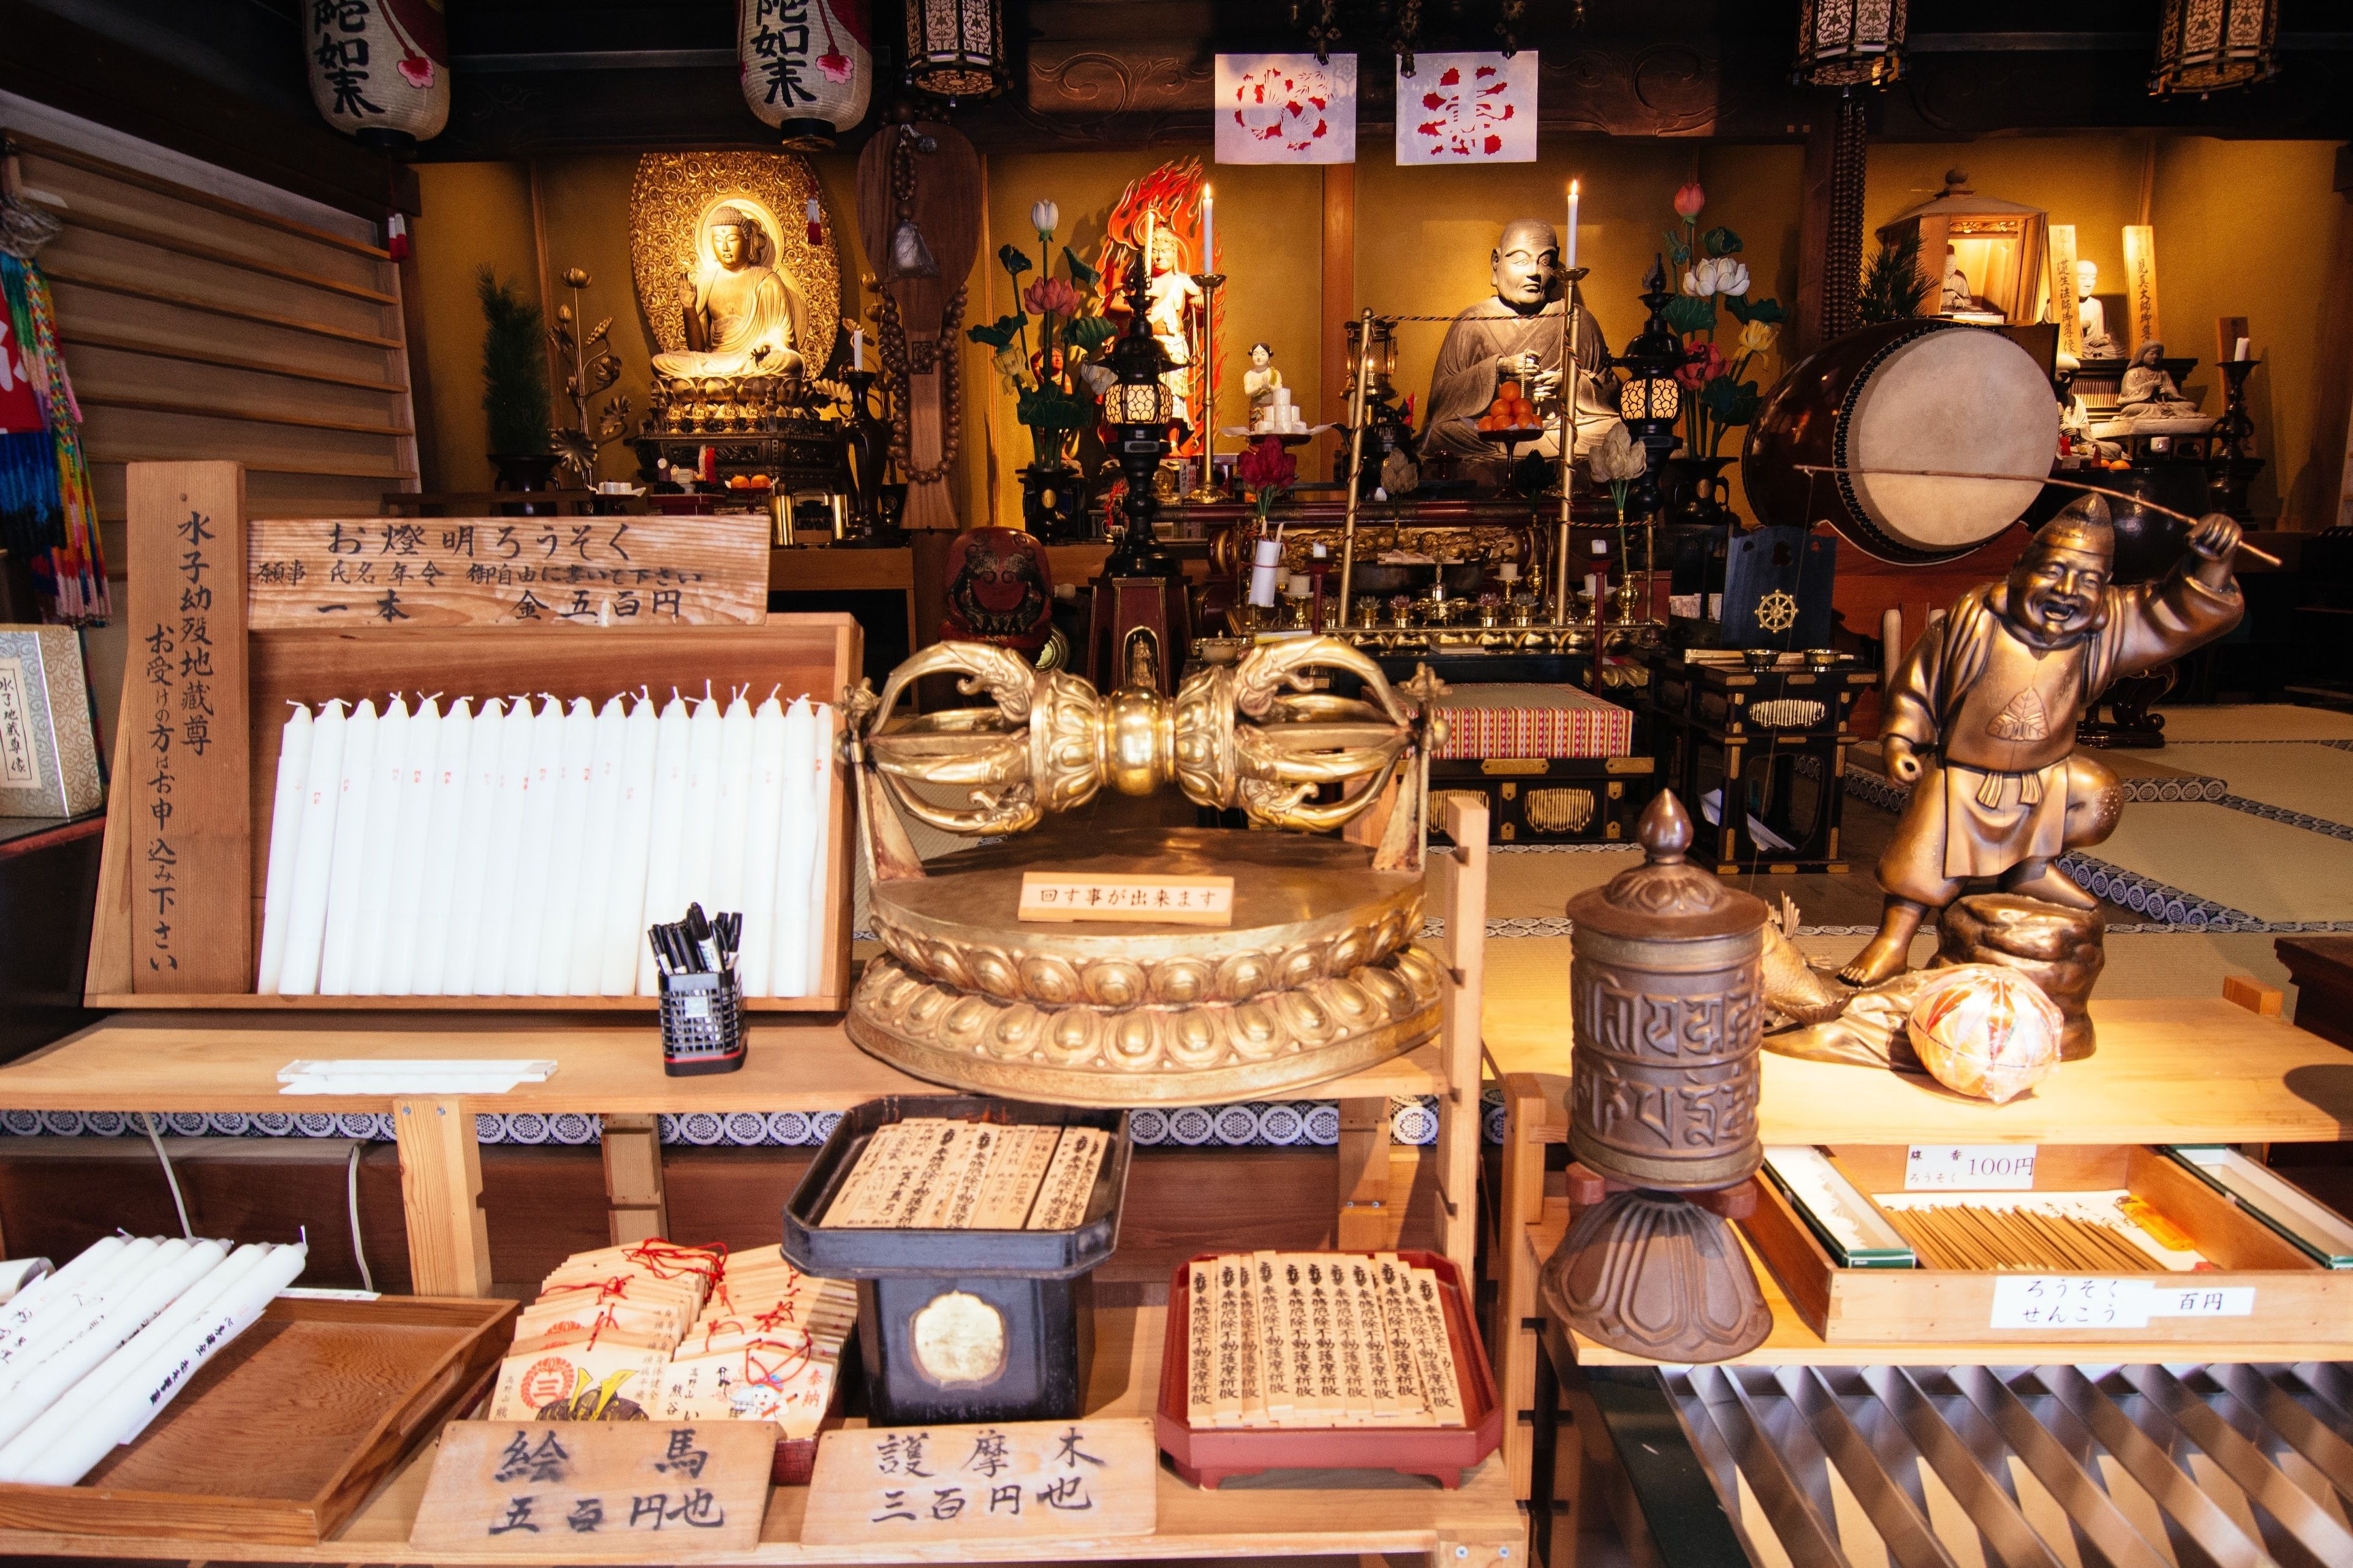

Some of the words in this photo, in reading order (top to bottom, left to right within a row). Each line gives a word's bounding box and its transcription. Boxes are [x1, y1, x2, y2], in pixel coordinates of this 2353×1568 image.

[509, 589, 683, 621] 金五百円
[1040, 887, 1217, 907] 回す事が出来ます
[1910, 1172, 1957, 1183] ろうそく
[1968, 1156, 2034, 1176] 100円
[2026, 1278, 2118, 1298] ろうそく
[2022, 1304, 2116, 1324] せんこう
[2180, 1292, 2224, 1311] 百円
[802, 1369, 824, 1407] 奉納
[494, 1429, 710, 1483] 絵馬
[876, 1427, 1105, 1478] 護摩木
[488, 1490, 726, 1536] 五百円也
[873, 1475, 1095, 1525] 三百円也
